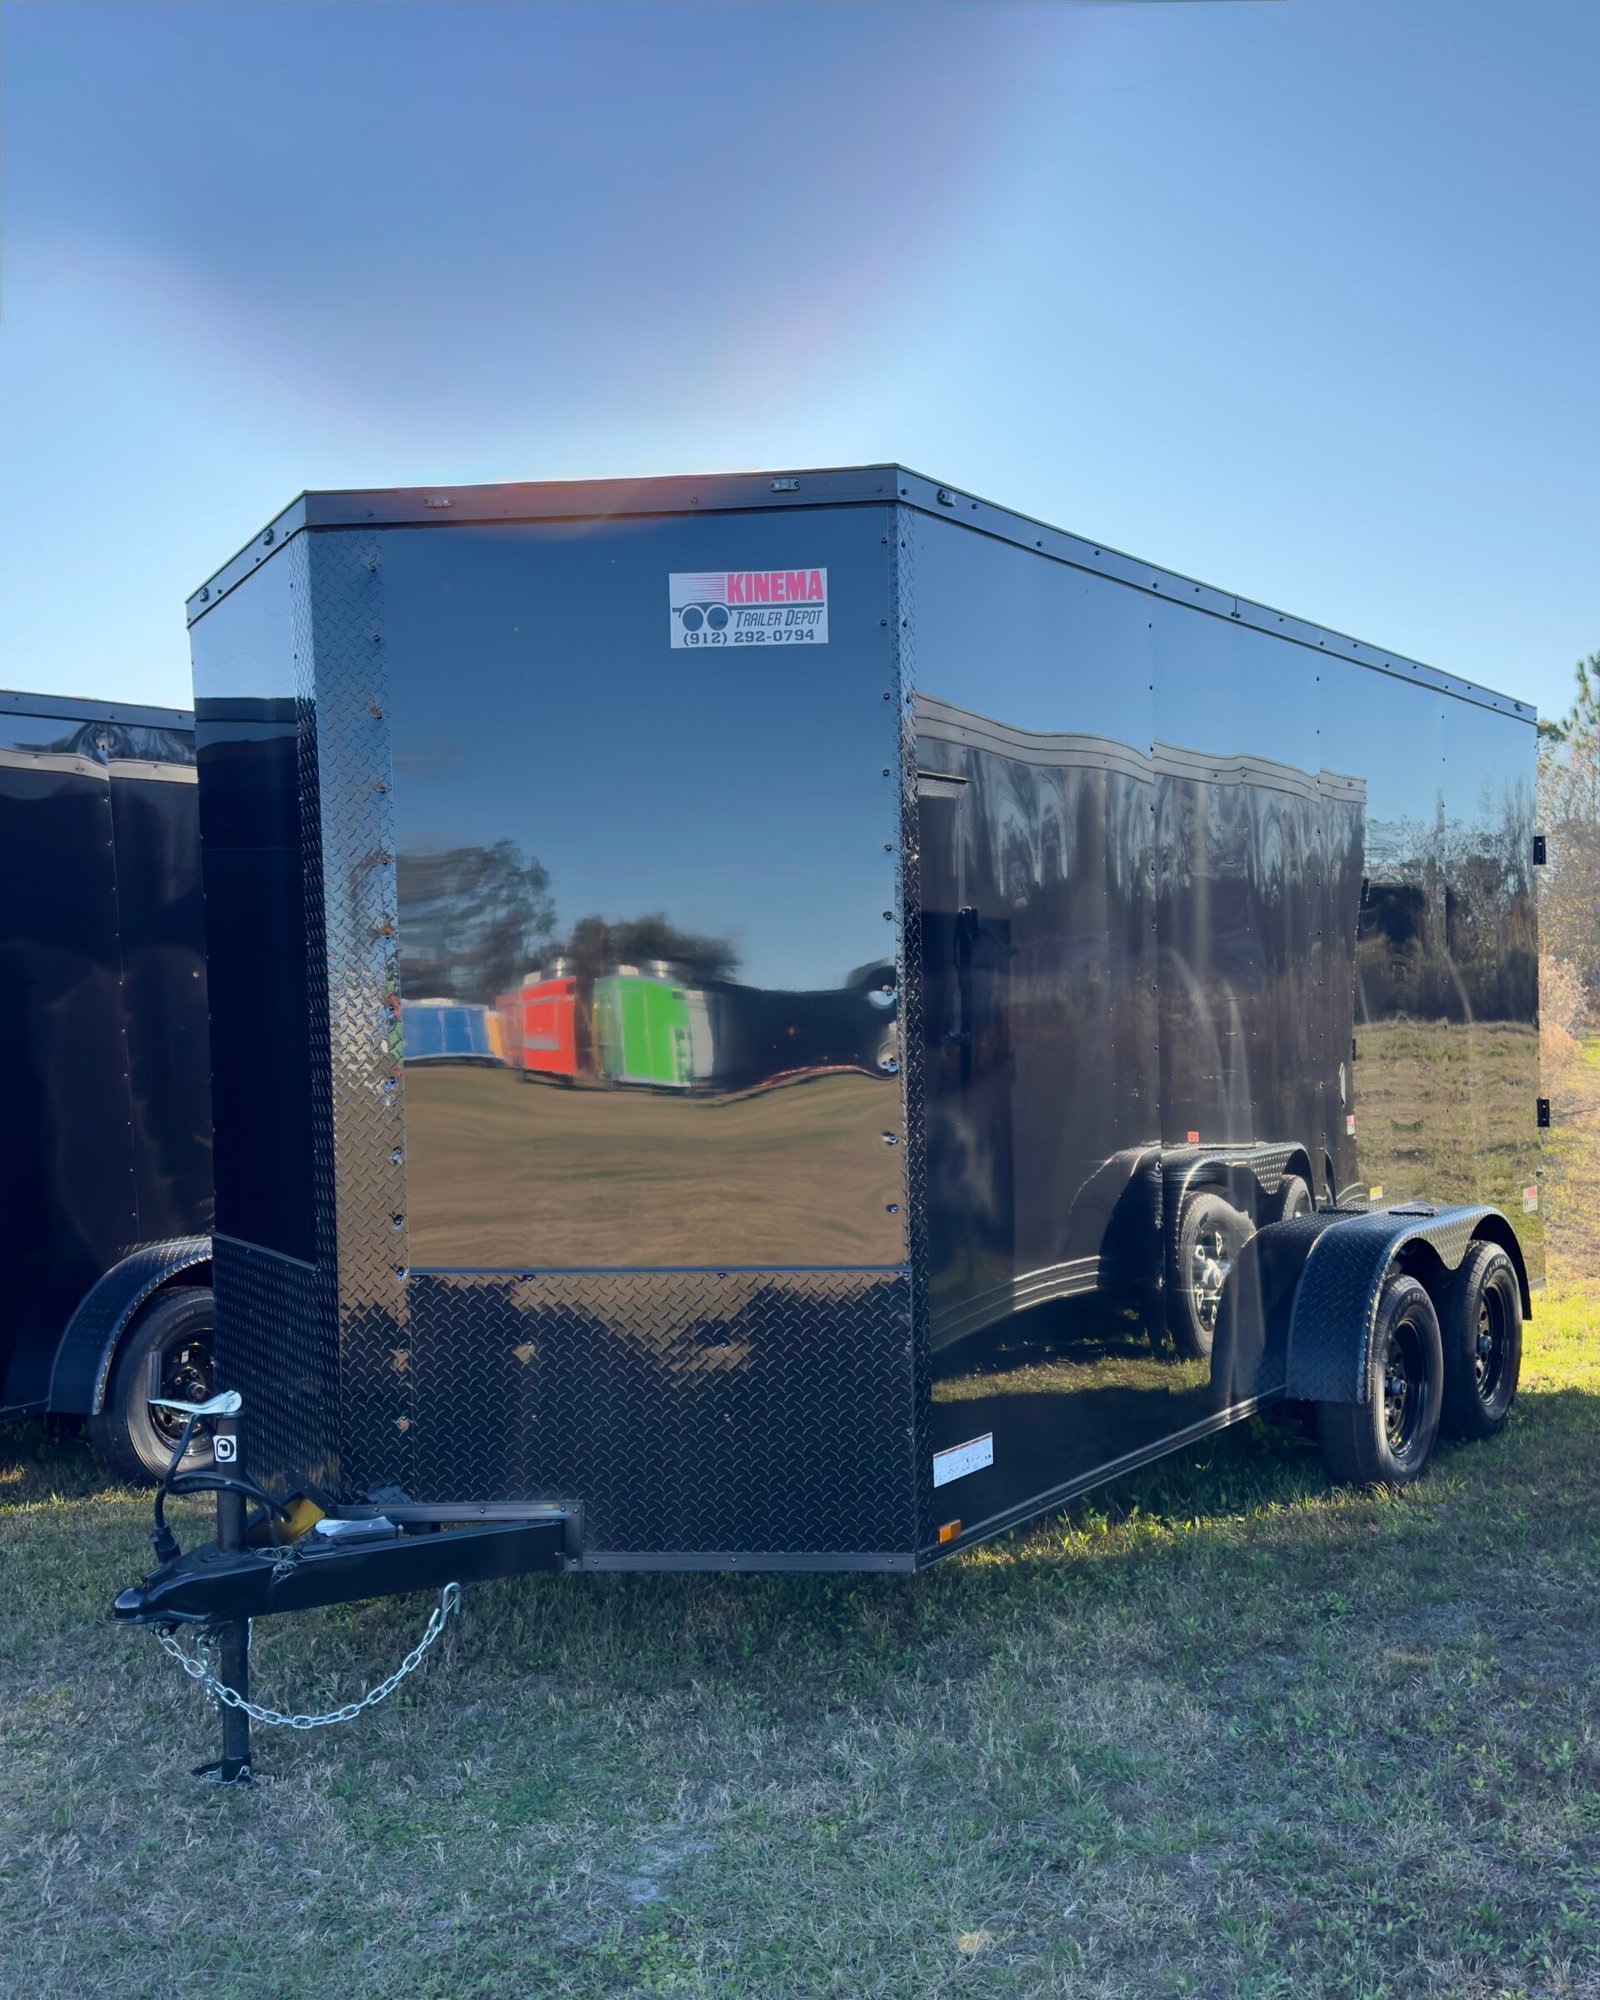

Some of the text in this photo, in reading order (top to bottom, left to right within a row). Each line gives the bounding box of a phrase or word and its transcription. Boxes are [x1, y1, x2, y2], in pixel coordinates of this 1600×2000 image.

[727, 571, 824, 603] KINEMA
[736, 609, 823, 628] TRAILER DEPOT
[683, 629, 815, 646] (912) 292-0794
